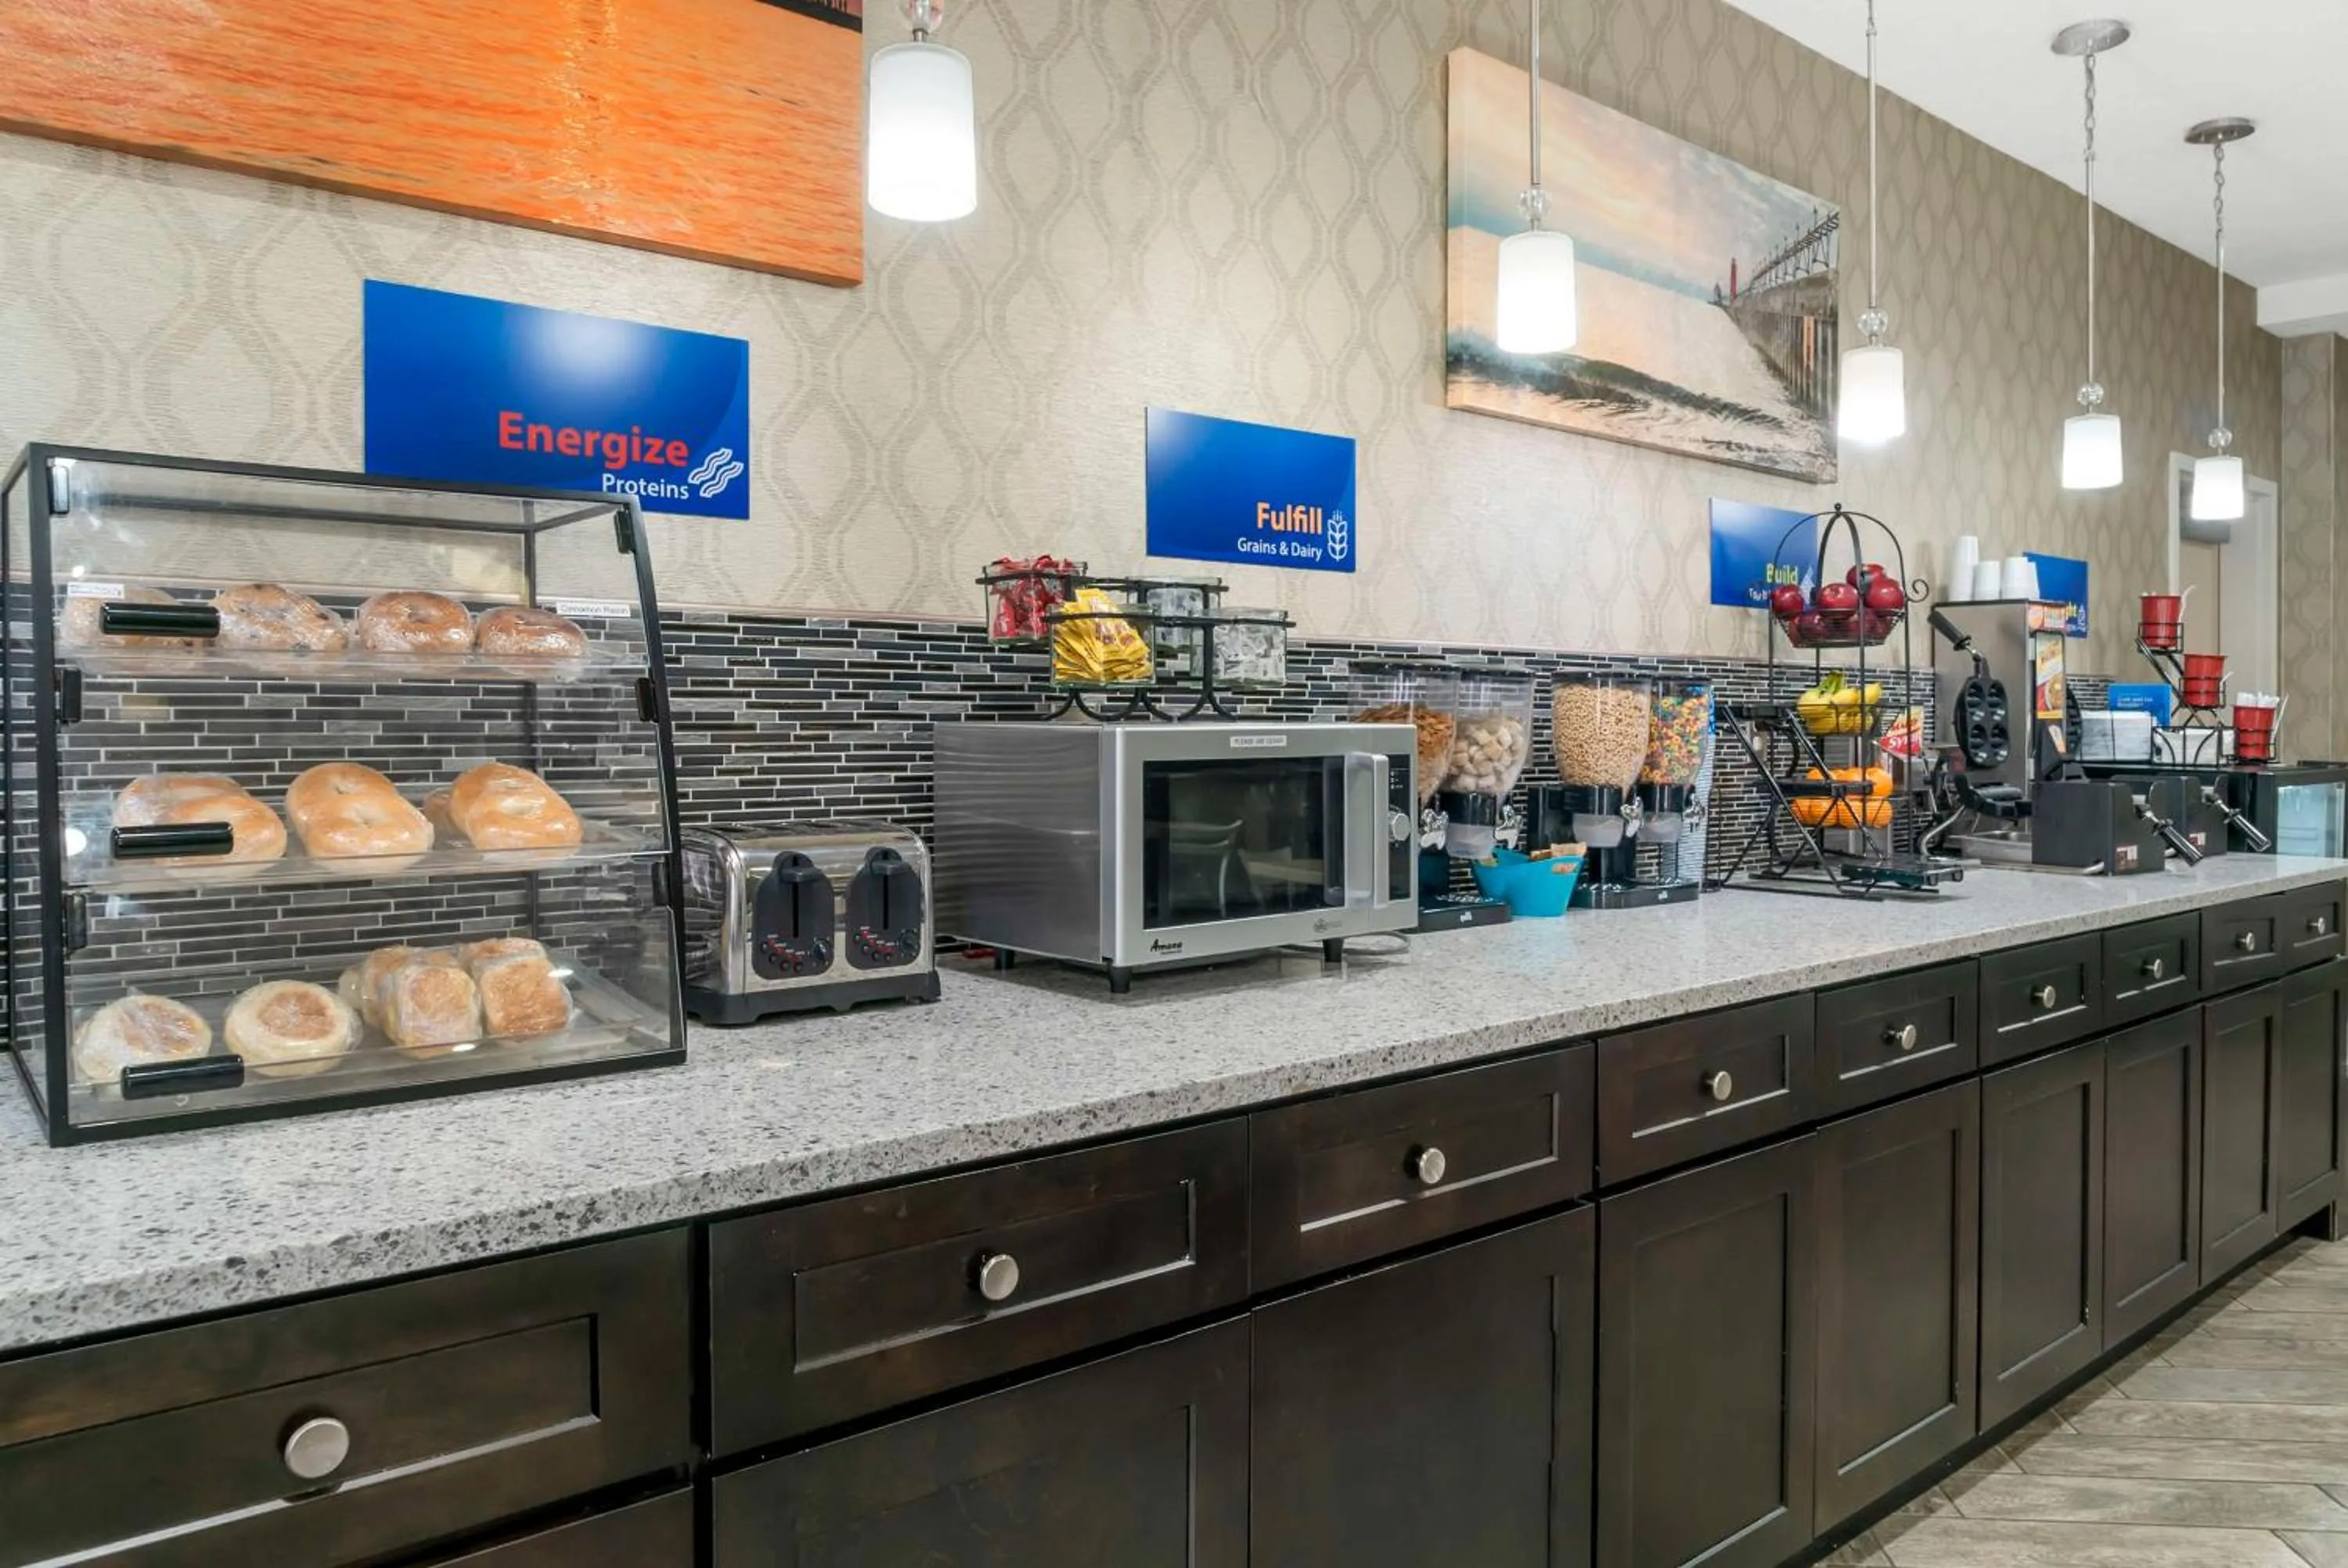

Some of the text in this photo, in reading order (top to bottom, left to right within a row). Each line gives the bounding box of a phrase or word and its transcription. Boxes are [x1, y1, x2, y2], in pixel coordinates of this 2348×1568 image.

[499, 410, 690, 470] Energize
[602, 473, 690, 499] Proteins
[1256, 501, 1323, 535] Fulfill
[1237, 537, 1323, 563] Grains & Dairy
[1766, 563, 1799, 585] Build
